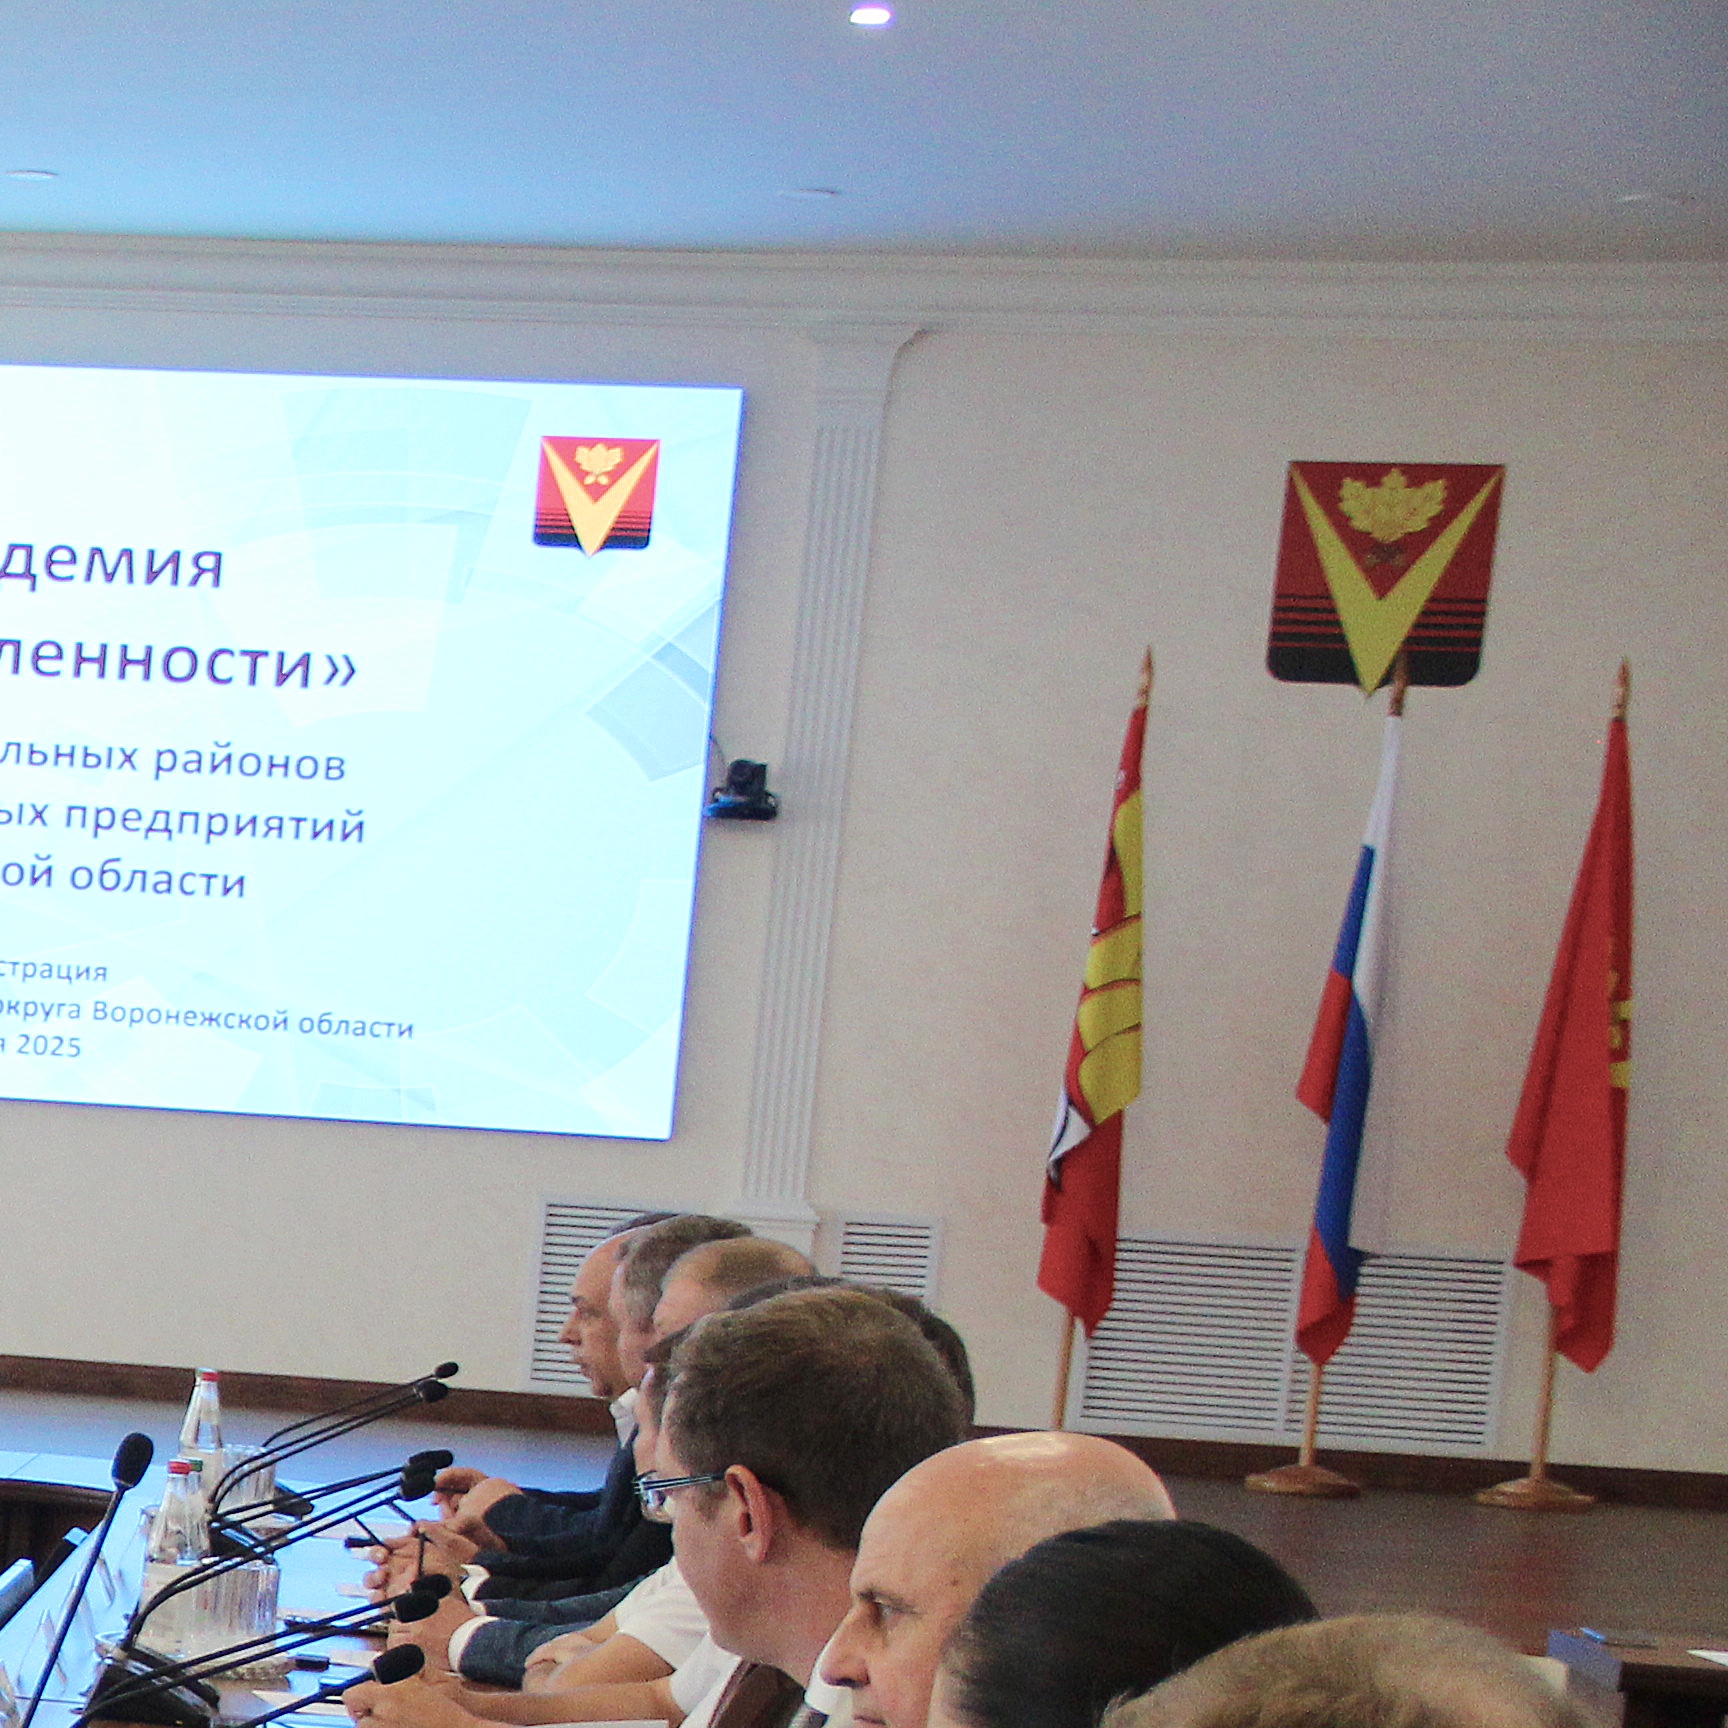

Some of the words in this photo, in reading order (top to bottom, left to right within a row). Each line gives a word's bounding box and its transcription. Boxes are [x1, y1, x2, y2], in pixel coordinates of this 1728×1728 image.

[154, 742, 346, 781] районов
[65, 806, 365, 845] предприятий
[69, 857, 246, 898] области
[92, 1000, 289, 1032] Воронежской
[298, 1012, 414, 1039] области
[16, 1033, 82, 1058] 2025
